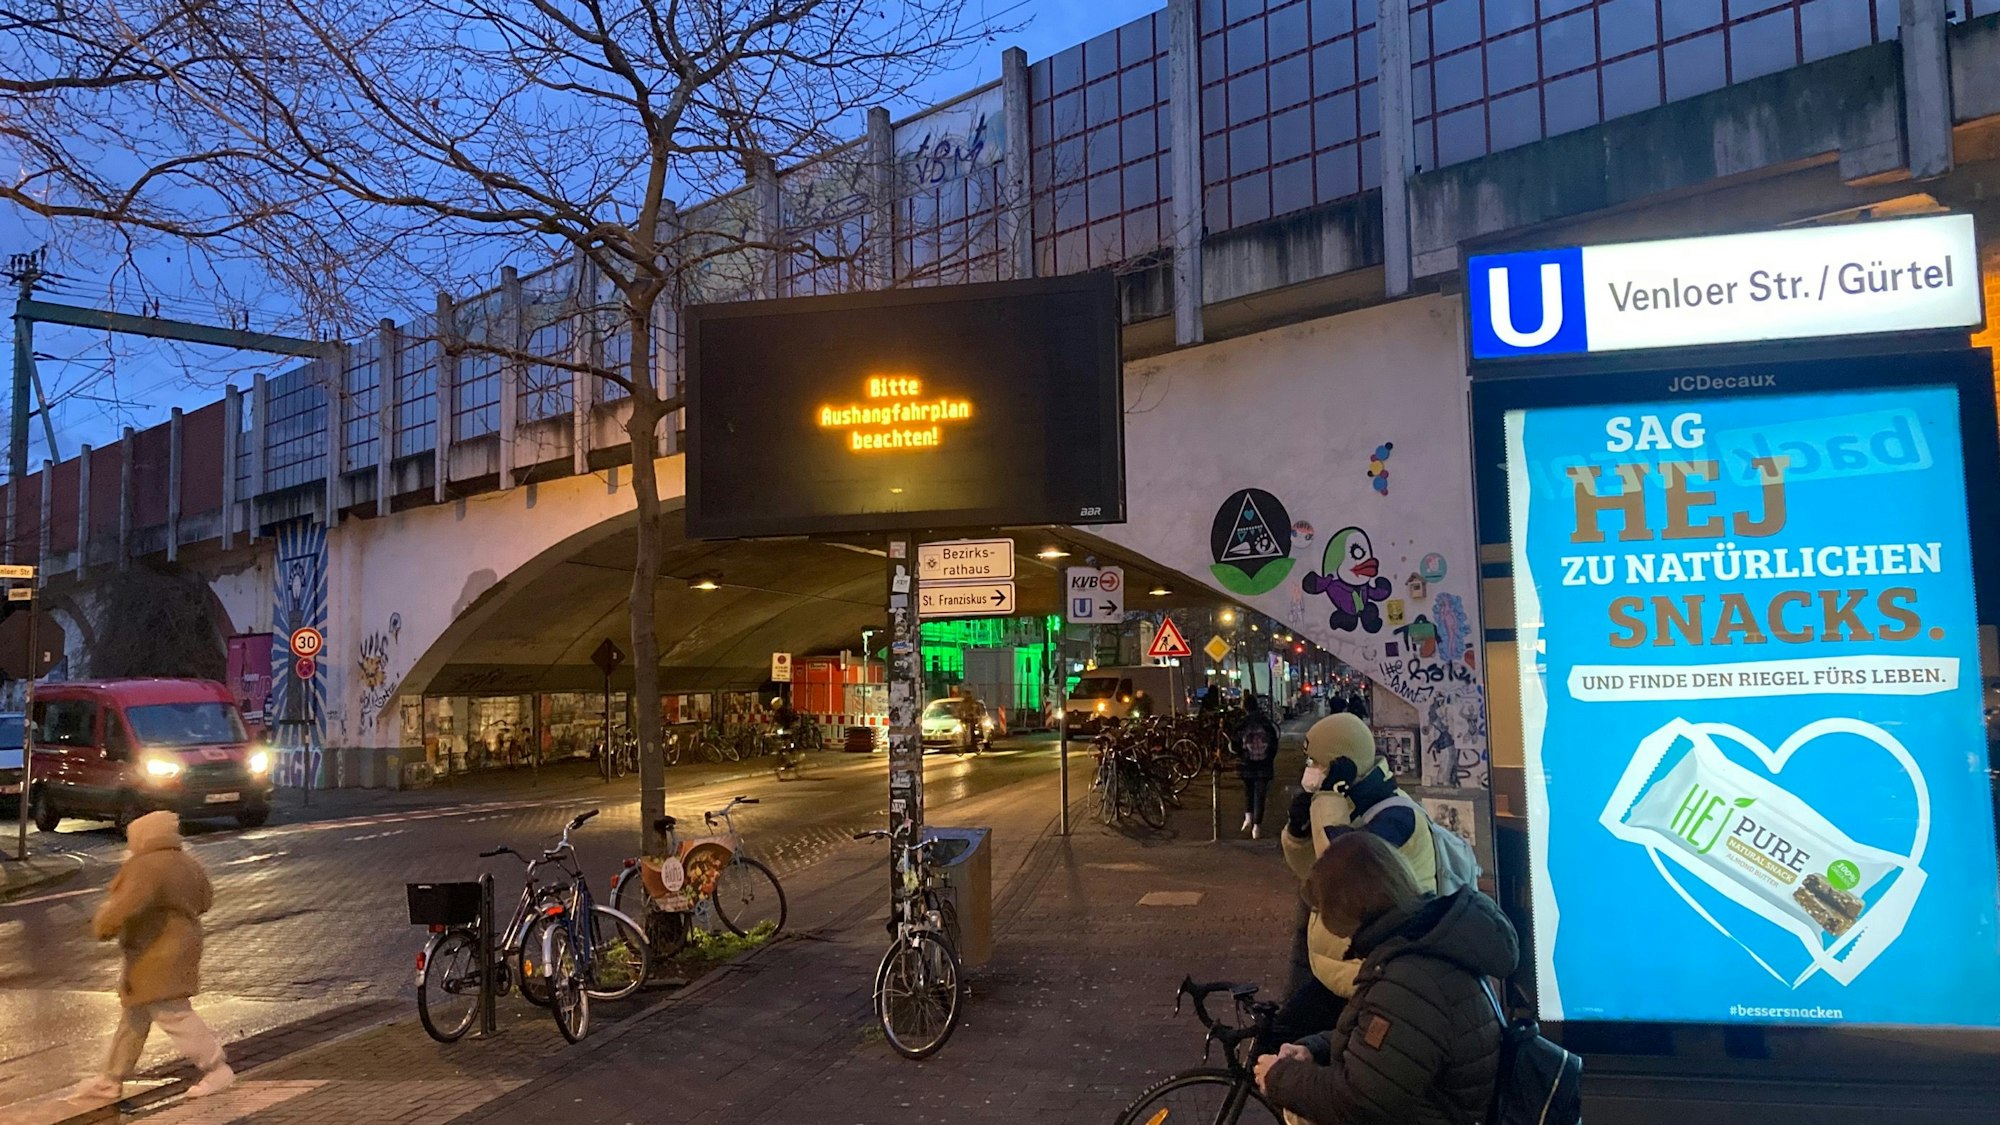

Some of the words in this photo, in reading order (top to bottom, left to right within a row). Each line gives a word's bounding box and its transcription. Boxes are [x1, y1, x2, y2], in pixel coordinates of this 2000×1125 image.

[1488, 264, 1563, 347] U
[1608, 279, 1738, 312] Venloer
[1748, 270, 1811, 302] Str.
[1817, 265, 1830, 300] /
[1838, 255, 1955, 296] Gürtel
[869, 378, 920, 398] Bitte
[1668, 374, 1777, 392] JCDecaux
[821, 400, 970, 426] Aushangfahrplan
[852, 426, 939, 450] beachten!
[1605, 413, 1706, 453] SAG
[1566, 456, 1790, 543] HEJ
[943, 548, 995, 559] Bezirks-
[1560, 555, 1616, 586] ZU
[1625, 542, 1942, 584] NATÜRLICHEN
[943, 564, 991, 575] rathaus
[1071, 576, 1099, 588] KVB
[922, 595, 935, 606] St.
[939, 594, 987, 605] Franziskus
[1074, 599, 1092, 617] U
[1607, 587, 1946, 649] SNACKS.
[298, 636, 316, 649] 30
[1582, 675, 1624, 690] UND
[1629, 673, 1688, 689] FINDE
[1692, 672, 1734, 688] DEN
[1738, 670, 1809, 686] RIEGEL
[1814, 666, 1867, 684] FÜRS
[1872, 668, 1947, 684] LEBEN.
[1670, 783, 1735, 855] HEJ
[1732, 816, 1811, 872] PURE
[1726, 853, 1755, 873] ALMOND
[1755, 869, 1779, 888] BUTTER
[1728, 840, 1765, 866] NATURAL
[1766, 862, 1795, 882] SNACK
[1837, 862, 1857, 882] 100%
[1729, 1004, 1844, 1019] #bessersnacken
